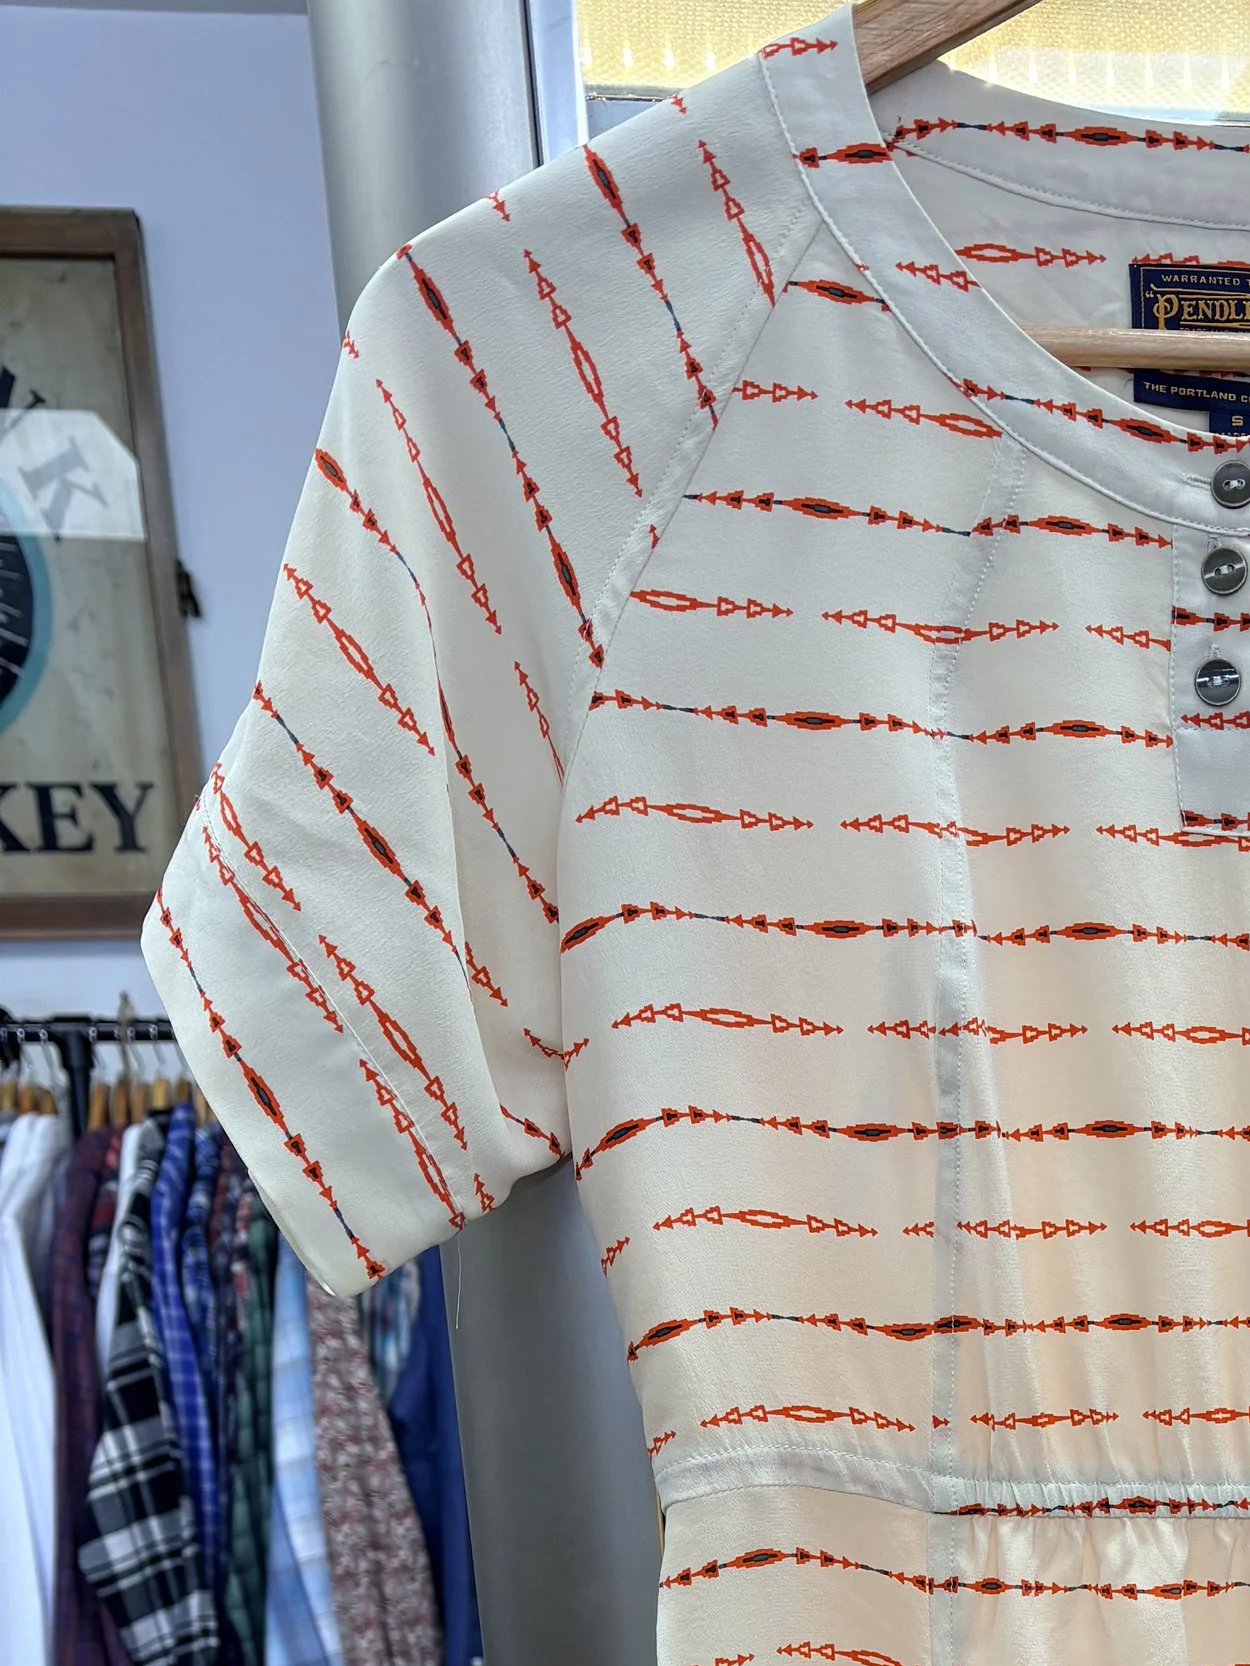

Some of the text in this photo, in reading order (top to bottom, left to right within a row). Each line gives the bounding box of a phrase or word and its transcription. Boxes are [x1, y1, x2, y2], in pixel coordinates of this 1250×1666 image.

[1161, 274, 1241, 286] WARRANTED
[1143, 382, 1167, 394] THE
[1170, 386, 1236, 402] PORTLAND
[1231, 415, 1244, 426] S
